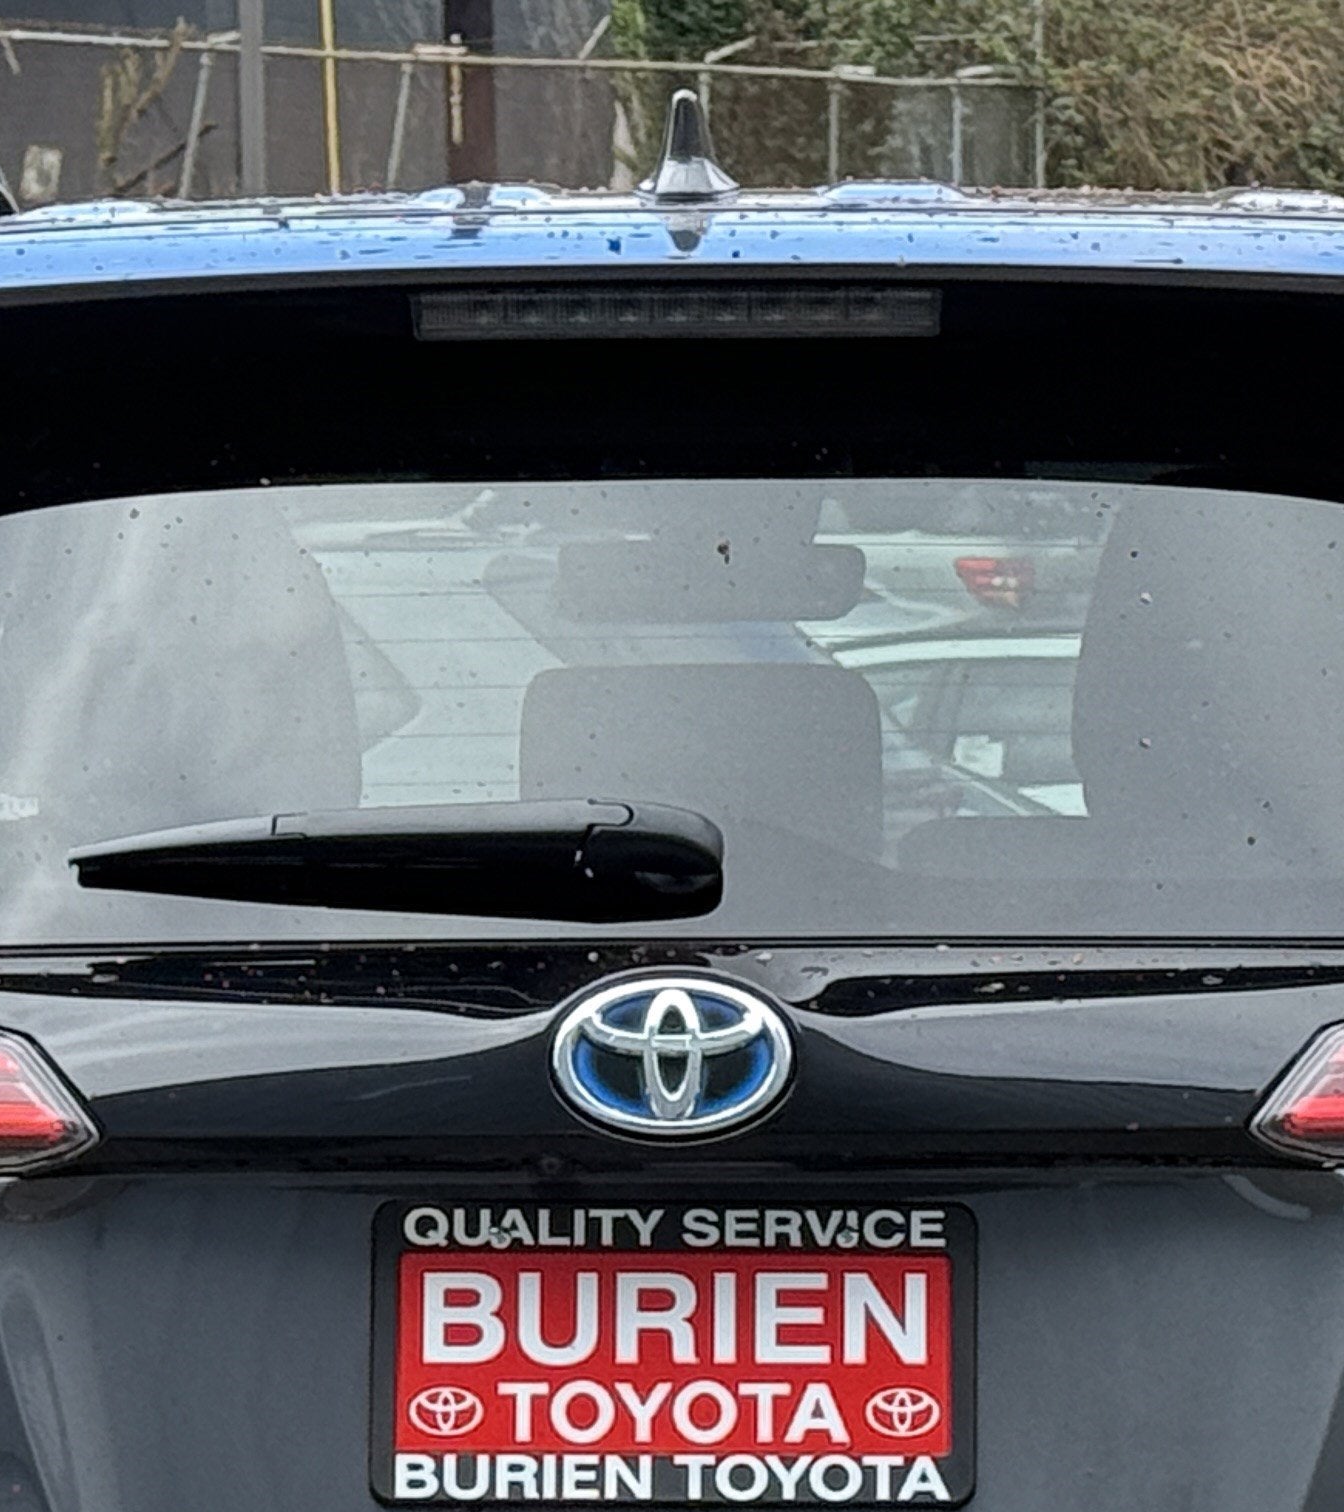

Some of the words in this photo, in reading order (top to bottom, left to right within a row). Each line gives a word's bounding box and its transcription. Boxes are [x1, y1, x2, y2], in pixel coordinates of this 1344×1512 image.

[404, 1206, 664, 1249] QUALITY
[682, 1209, 946, 1248] SERVICE
[422, 1271, 929, 1366] BURIEN
[498, 1379, 851, 1445] TOYOTA
[394, 1454, 654, 1501] BURIEN
[672, 1456, 952, 1502] TOYOTA
